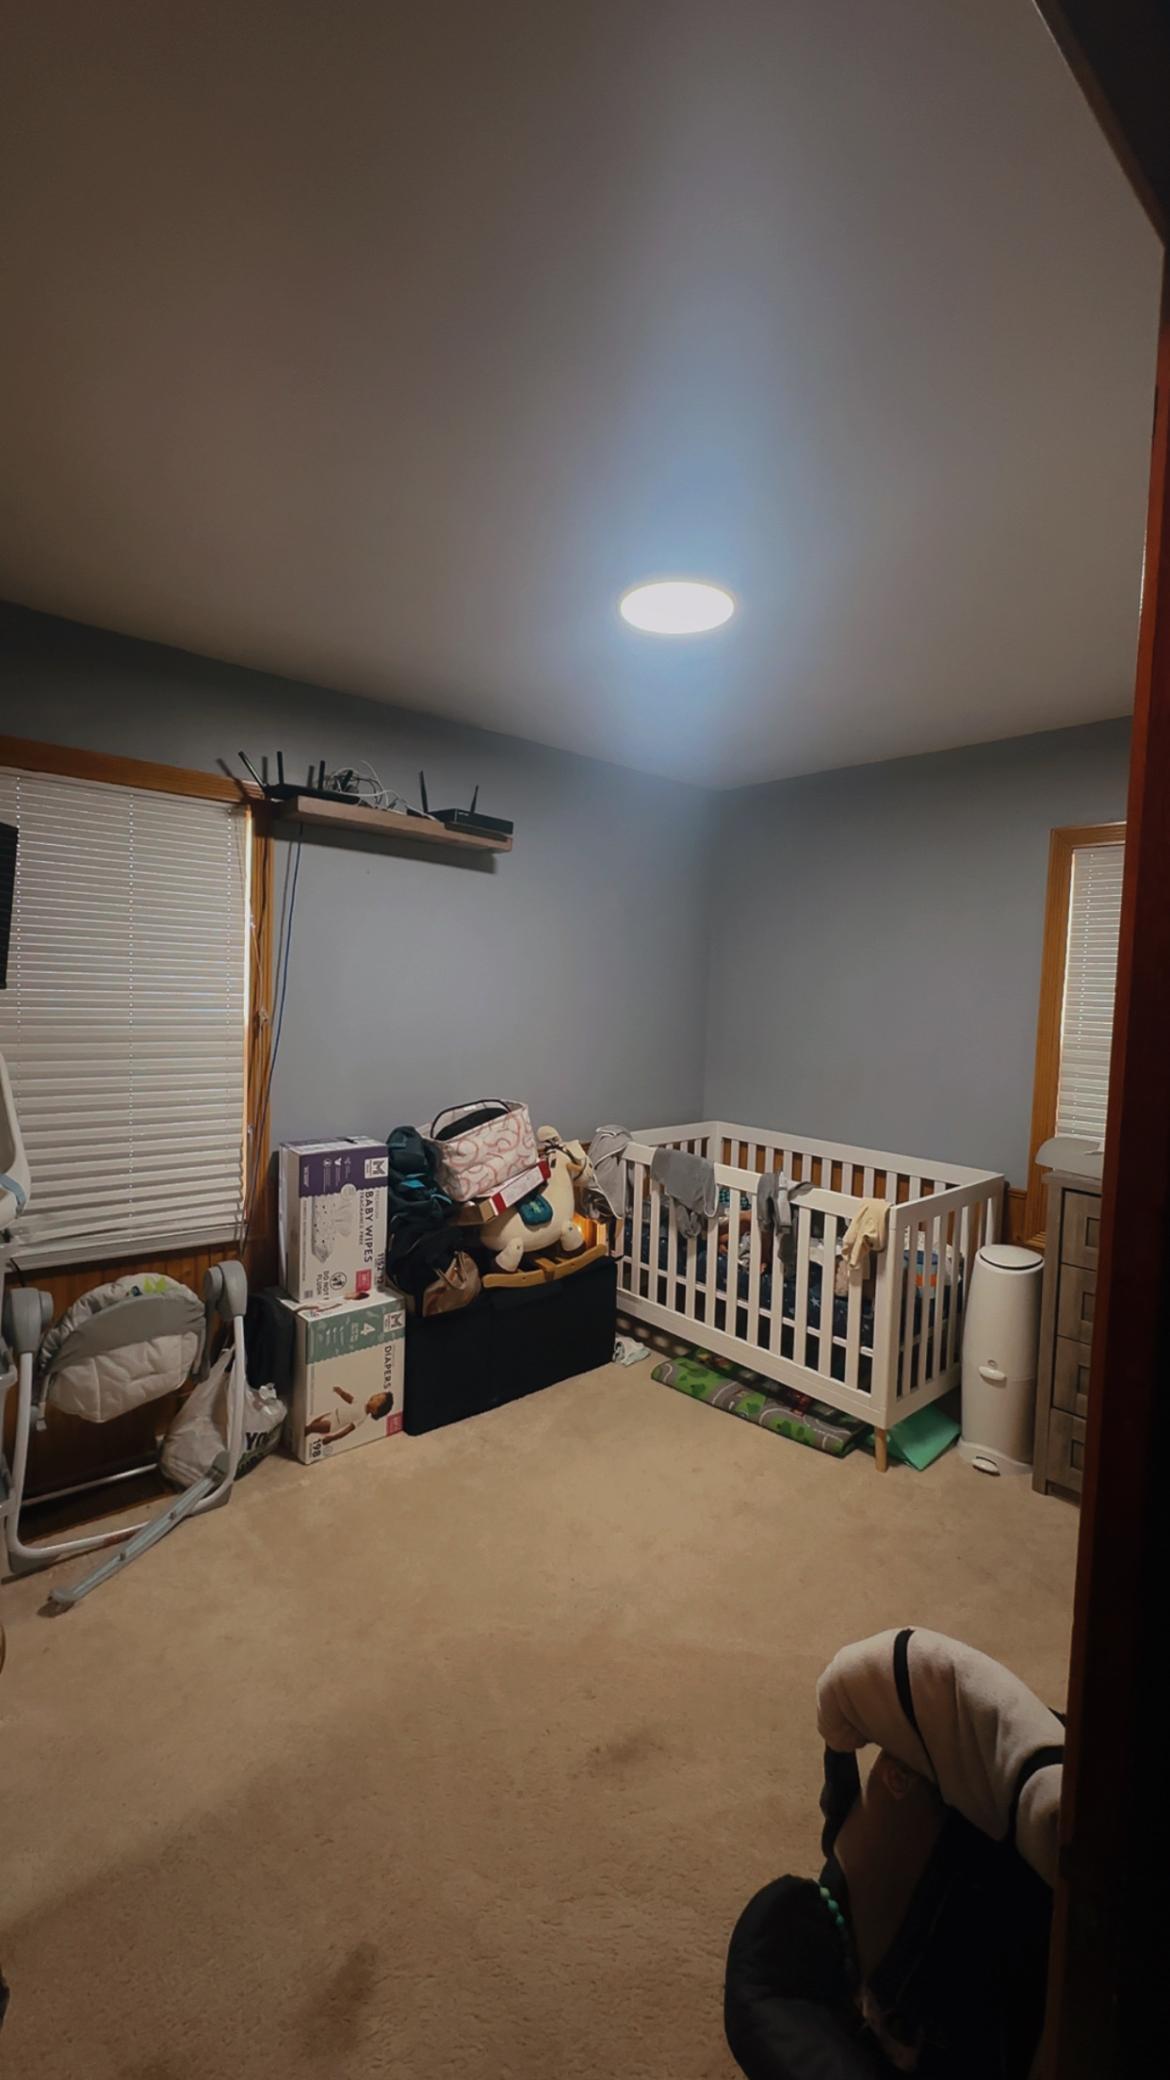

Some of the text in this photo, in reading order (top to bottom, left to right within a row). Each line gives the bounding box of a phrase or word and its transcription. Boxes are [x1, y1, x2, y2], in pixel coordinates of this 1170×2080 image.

[364, 1190, 374, 1263] BABY WIPES
[361, 1322, 376, 1335] 4
[383, 1345, 392, 1389] DIAPERS
[312, 1438, 322, 1458] 198
